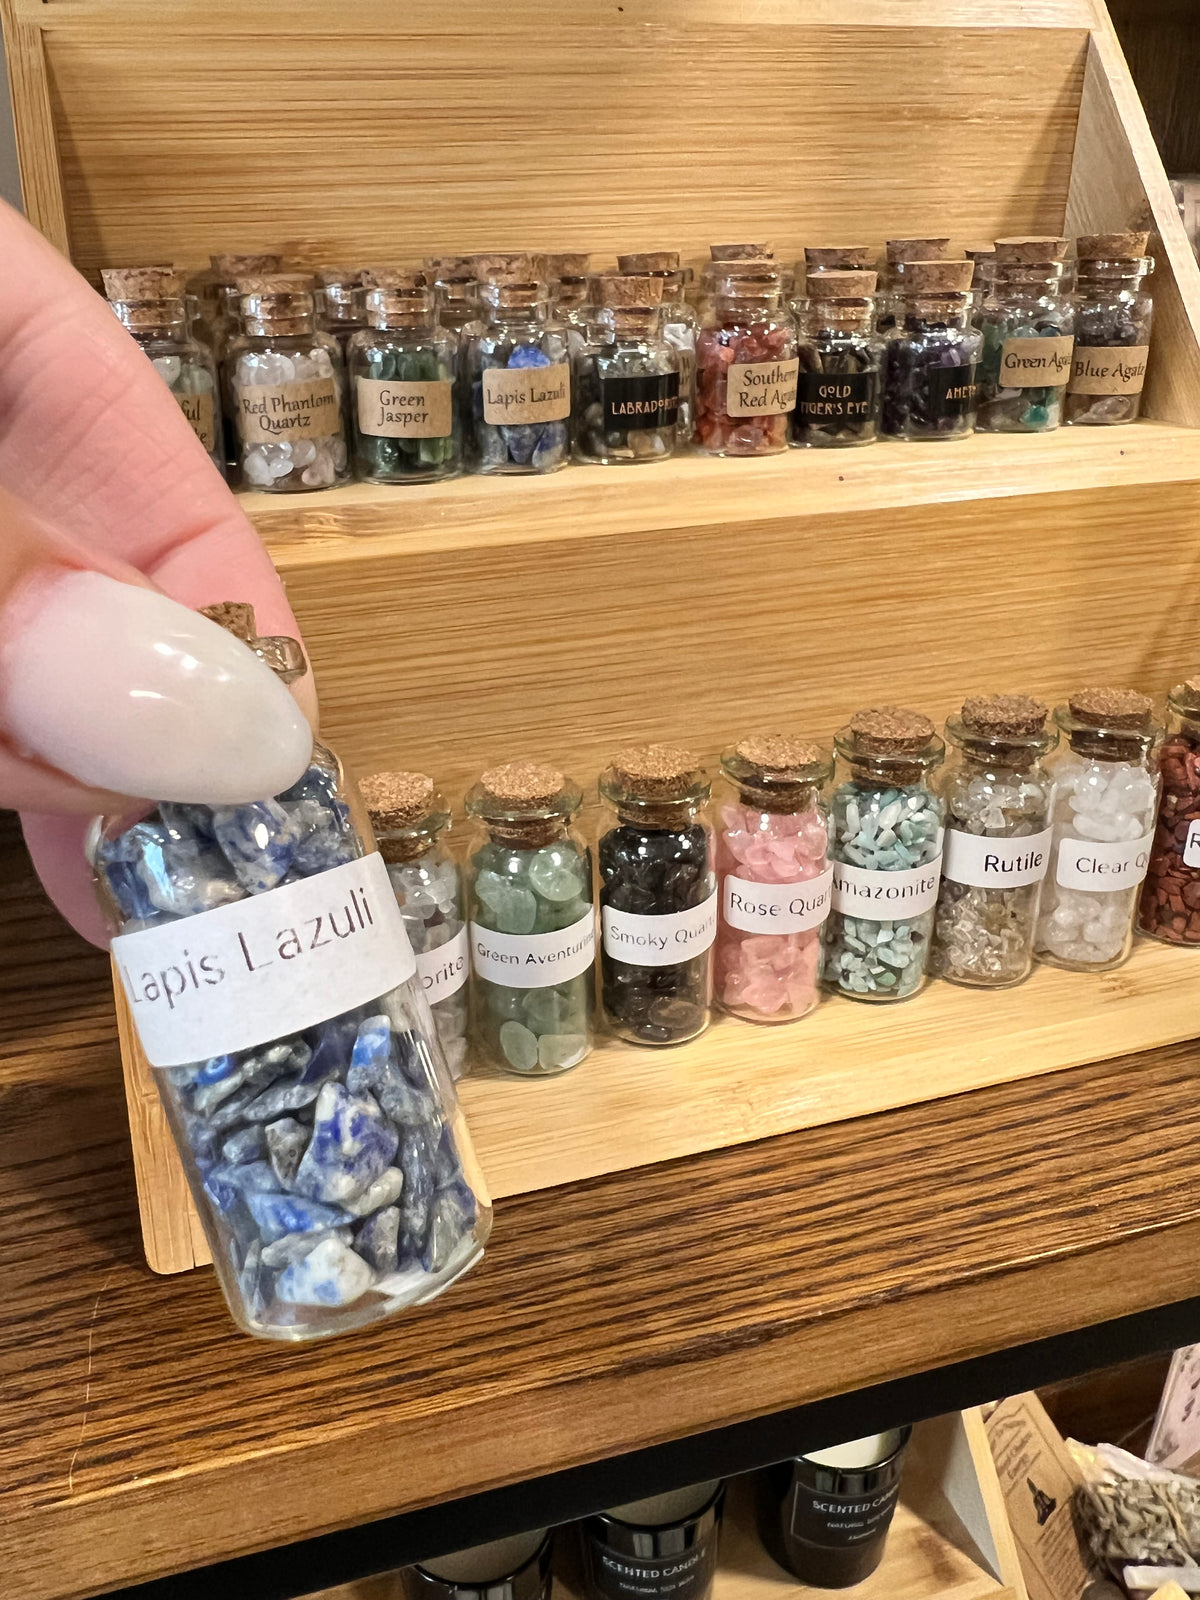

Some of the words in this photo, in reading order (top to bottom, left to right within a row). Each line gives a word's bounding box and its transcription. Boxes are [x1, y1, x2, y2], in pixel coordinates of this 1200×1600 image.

[1004, 352, 1046, 369] Green
[1075, 360, 1109, 377] Blue
[379, 389, 426, 406] Green
[486, 388, 526, 410] Lapis
[530, 381, 566, 403] Lazuli
[738, 388, 767, 408] Red
[818, 385, 852, 398] GOLD
[242, 396, 268, 415] Red
[271, 393, 334, 413] Phantom
[847, 401, 869, 415] EYE
[259, 413, 311, 435] Quartz
[377, 409, 430, 426] Jasper
[984, 851, 1043, 873] Rutile
[1075, 856, 1130, 874] Clear
[730, 892, 782, 917] Rose
[610, 925, 668, 950] Smoky
[122, 949, 225, 1010] Lapis
[237, 887, 374, 972] Lazuli
[477, 942, 520, 965] Green
[812, 1499, 871, 1514] SCENTED
[602, 1555, 660, 1579] SCENTED
